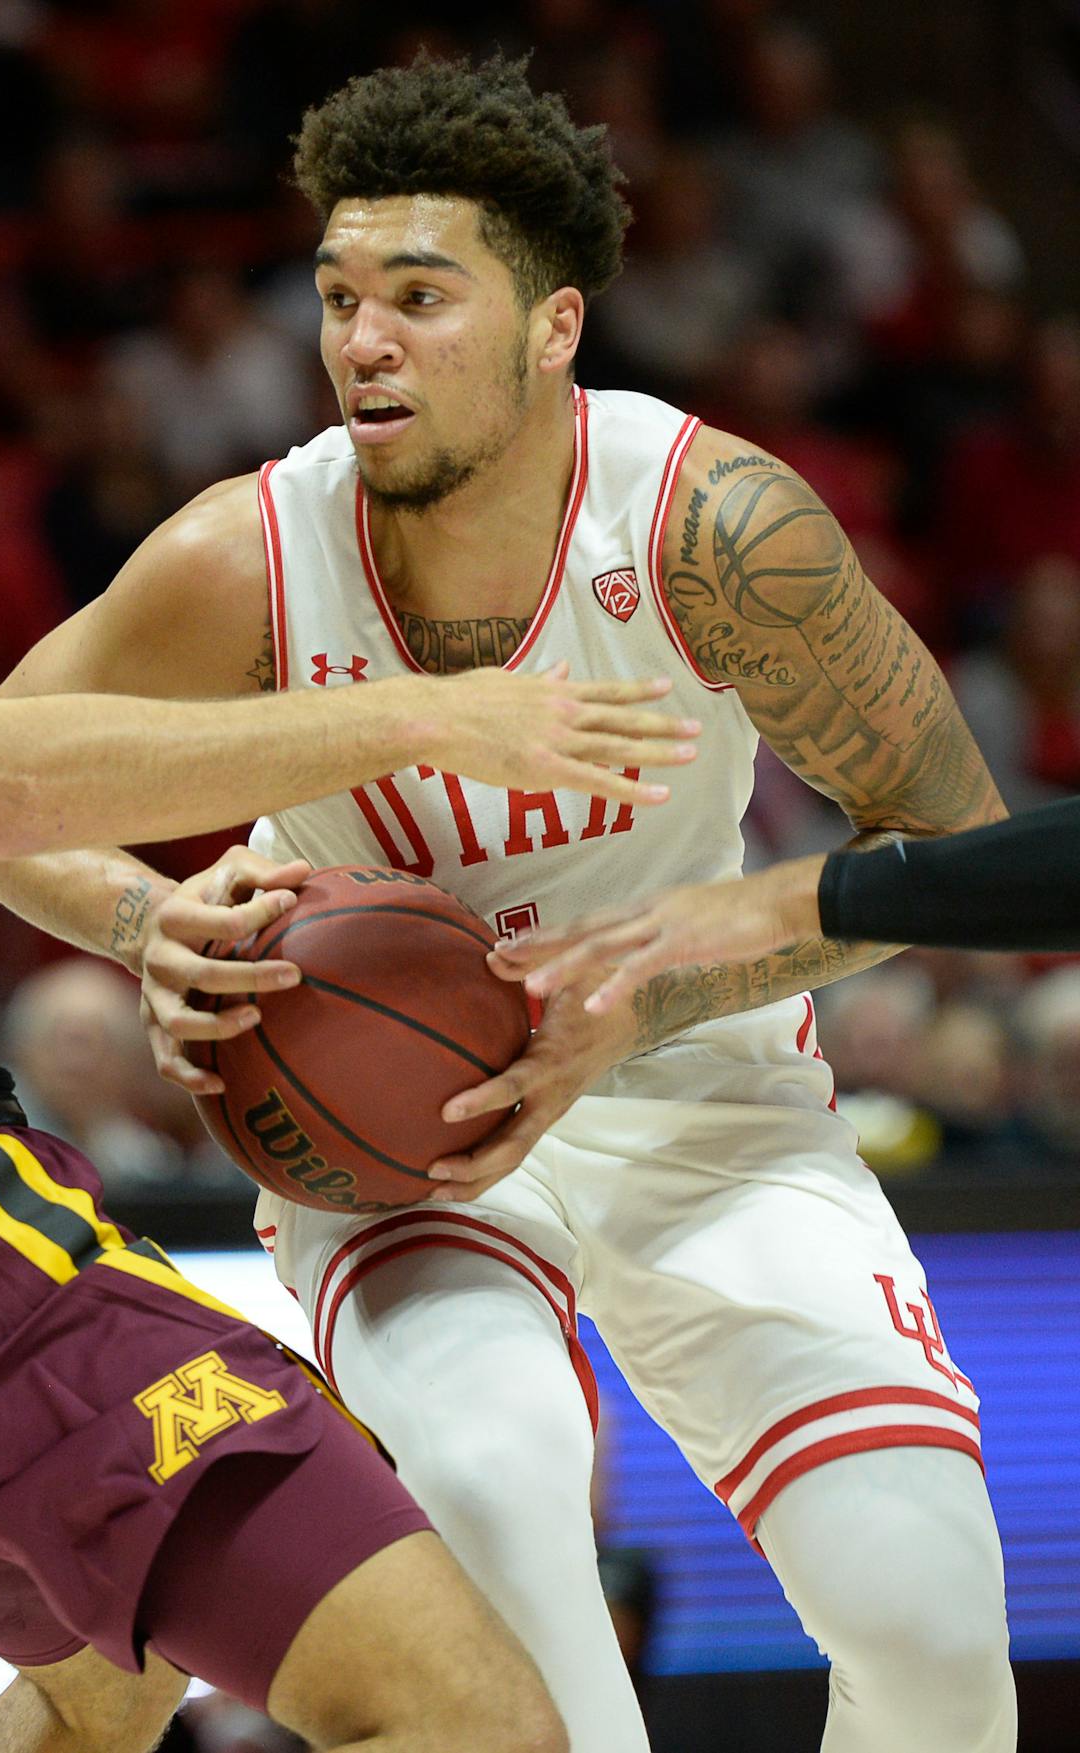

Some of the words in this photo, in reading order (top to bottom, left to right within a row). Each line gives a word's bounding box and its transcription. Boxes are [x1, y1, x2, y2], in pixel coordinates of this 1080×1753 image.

[594, 570, 639, 607] PAC
[610, 591, 635, 615] 12
[133, 1350, 289, 1486] M
